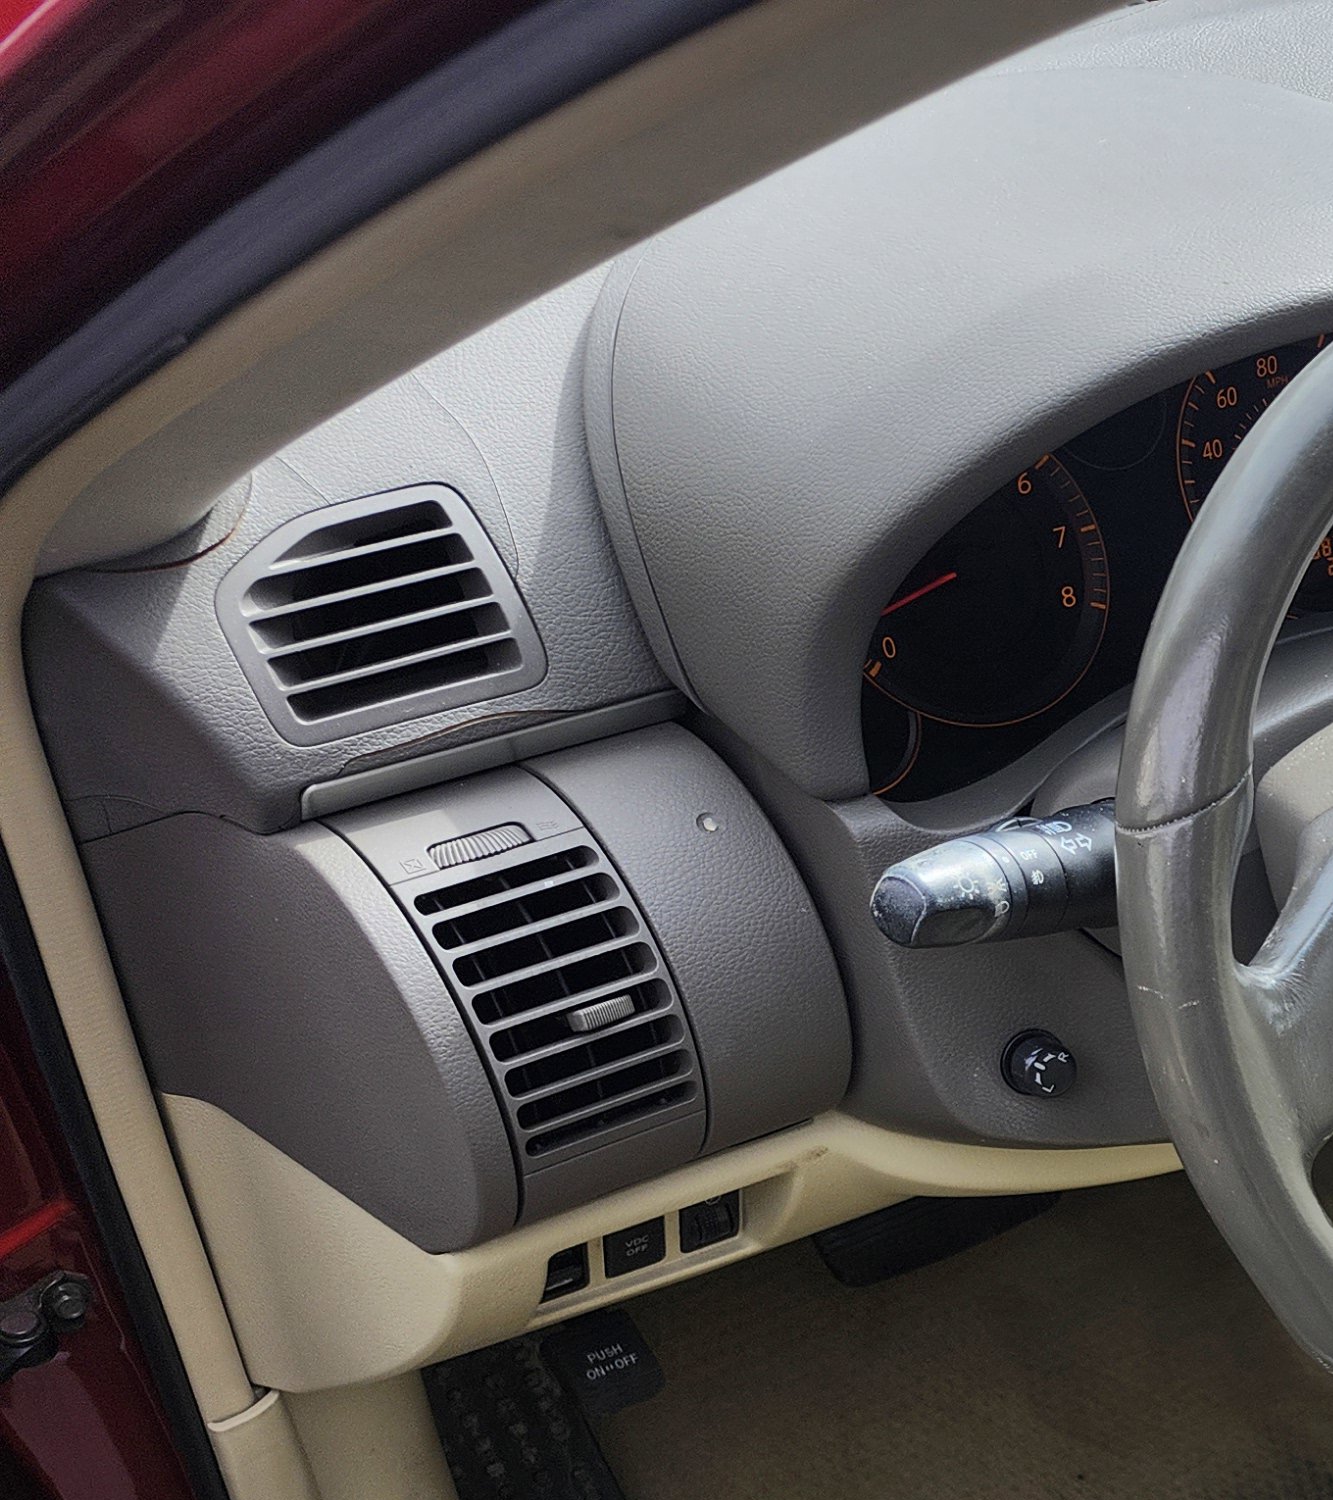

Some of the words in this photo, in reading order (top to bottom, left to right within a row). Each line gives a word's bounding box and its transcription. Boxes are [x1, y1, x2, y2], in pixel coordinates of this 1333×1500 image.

[1256, 355, 1278, 378] 80
[1266, 376, 1290, 389] MPH
[1216, 386, 1238, 409] 60
[1202, 439, 1223, 459] 40
[1017, 472, 1033, 495] 6
[1052, 525, 1066, 549] 7
[1061, 586, 1077, 608] 8
[882, 636, 897, 660] 0
[1020, 848, 1038, 861] OFF
[1057, 1051, 1070, 1064] R
[1041, 1084, 1055, 1094] L
[625, 1234, 650, 1249] VDC
[626, 1243, 649, 1257] OFF
[586, 1343, 623, 1364] PUSH
